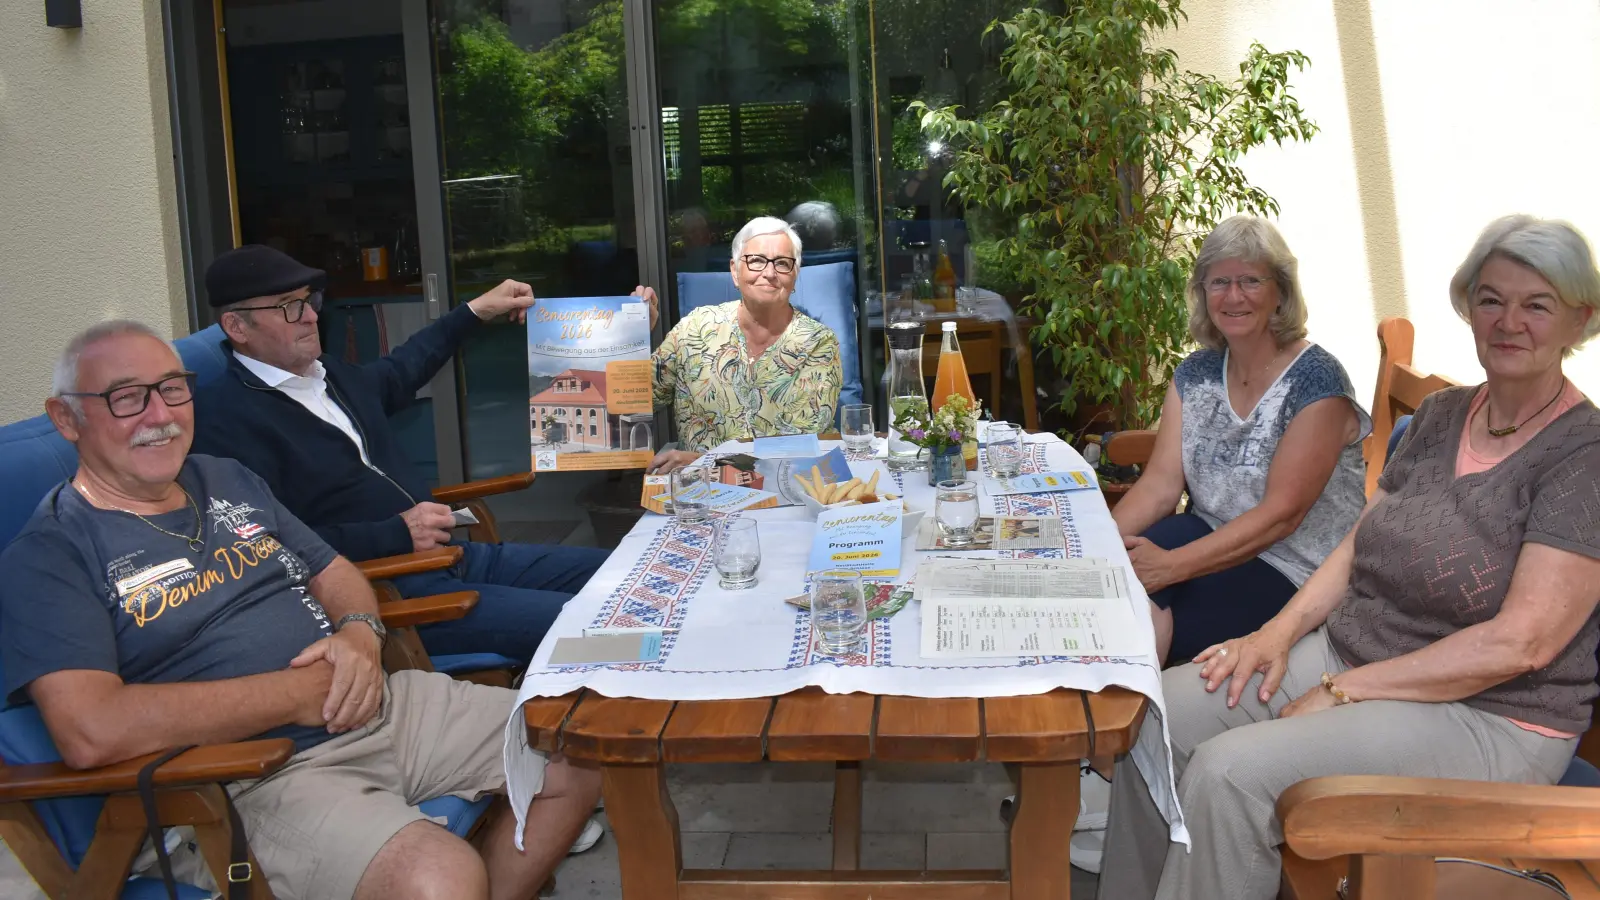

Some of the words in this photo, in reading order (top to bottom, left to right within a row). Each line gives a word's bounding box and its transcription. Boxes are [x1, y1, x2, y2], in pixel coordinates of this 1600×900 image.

[535, 305, 615, 329] Seniorentag
[535, 343, 546, 351] Mit
[546, 345, 582, 355] Bewegung
[822, 511, 898, 531] Seniorentag
[828, 539, 884, 549] Programm
[125, 570, 225, 628] Denim
